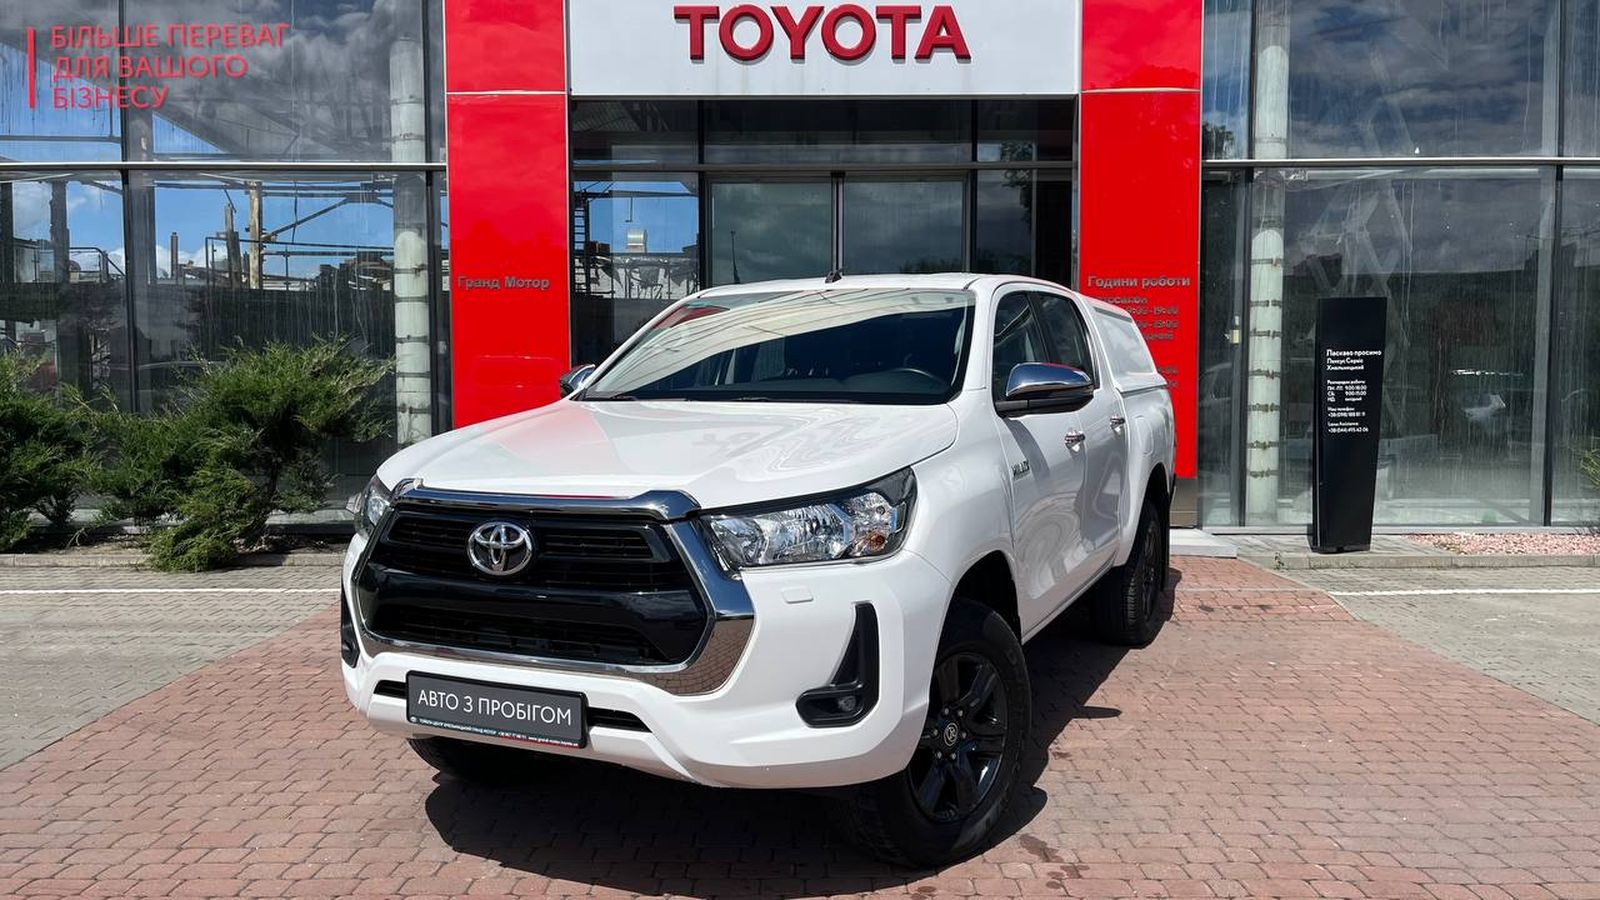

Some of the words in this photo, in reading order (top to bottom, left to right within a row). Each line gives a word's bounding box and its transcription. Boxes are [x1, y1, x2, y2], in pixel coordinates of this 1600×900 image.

[51, 25, 157, 49] БІЛЬШЕ
[167, 23, 289, 48] ПЕРЕВАГ
[673, 4, 972, 63] TOYOTA
[53, 56, 110, 82] ДЛЯ
[119, 54, 249, 79] ВАШОГО
[53, 84, 169, 110] БІЗНЕСУ
[457, 275, 500, 291] Гранд
[504, 275, 550, 291] Мотор
[1087, 275, 1138, 289] Години
[1142, 275, 1191, 289] роботи
[418, 689, 459, 710] АВТО
[477, 697, 572, 726] ПРОБІГОМ
